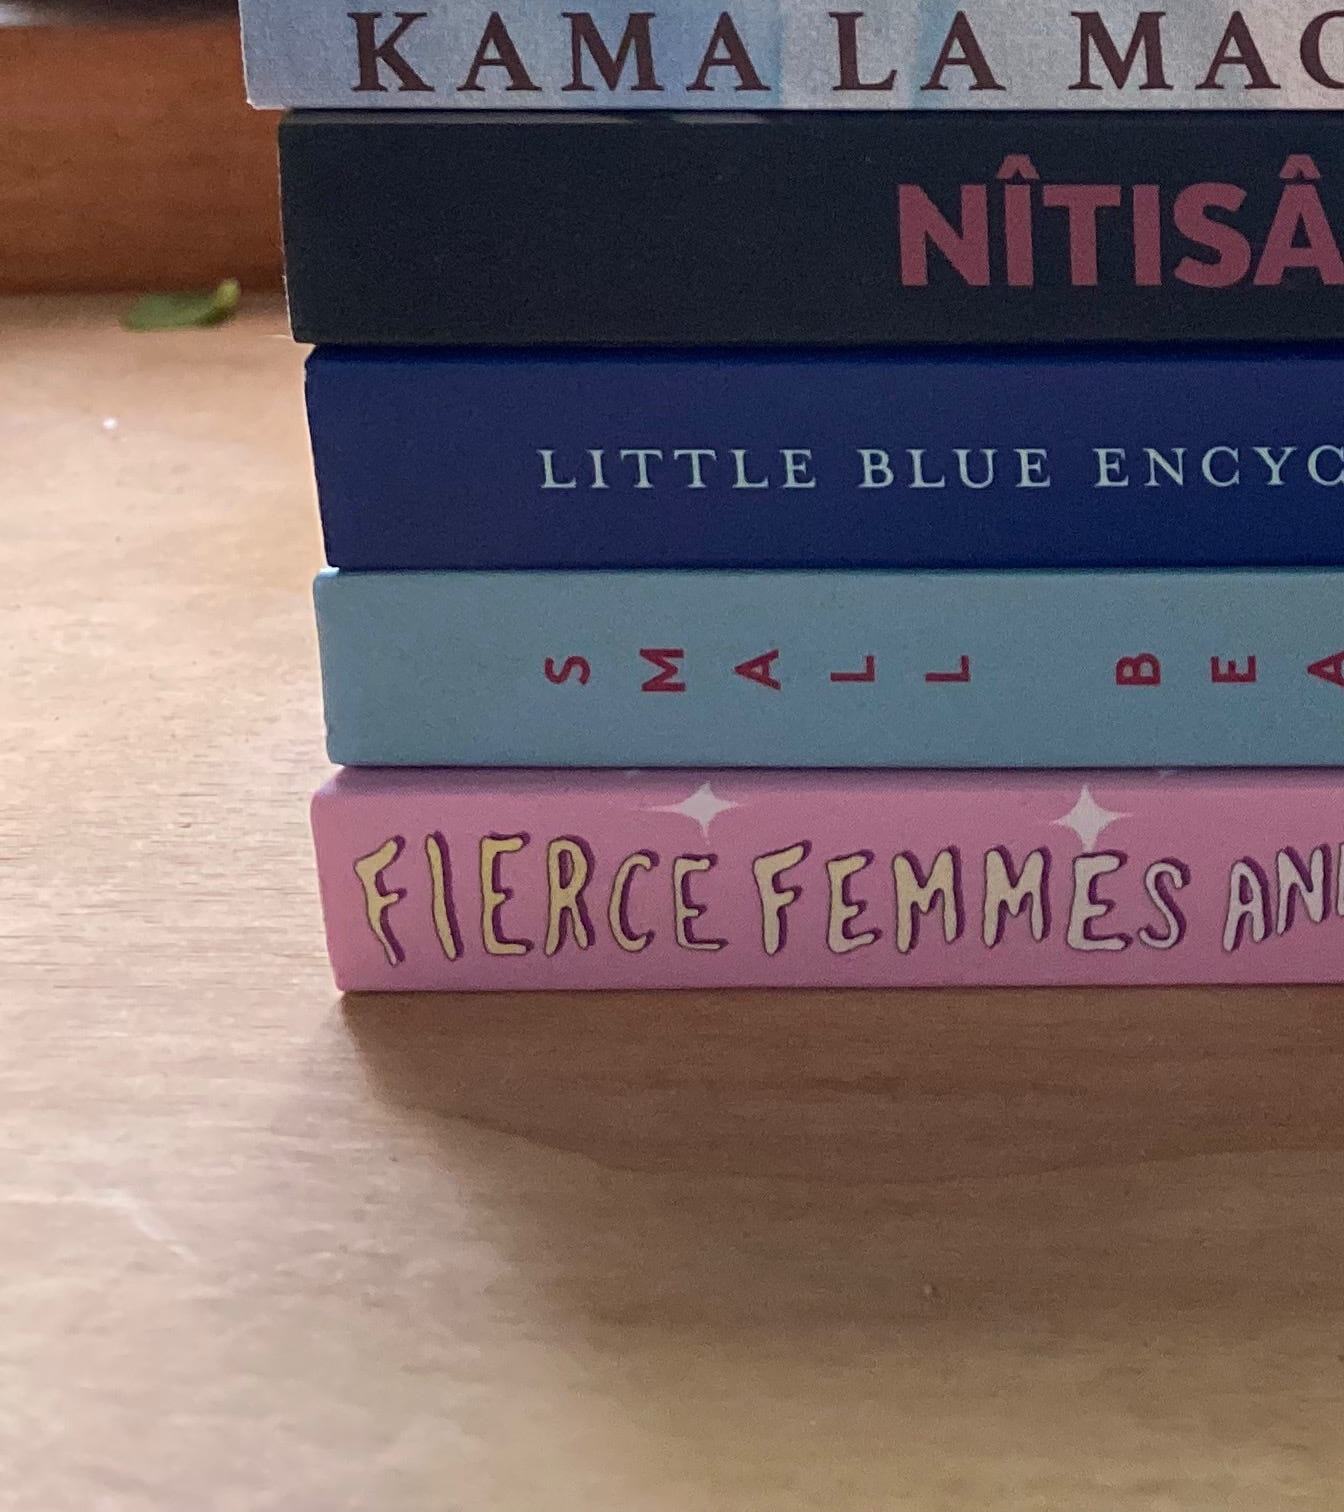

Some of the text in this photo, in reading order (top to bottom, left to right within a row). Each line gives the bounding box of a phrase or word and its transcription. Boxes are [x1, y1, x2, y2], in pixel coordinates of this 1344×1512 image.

[346, 10, 771, 92] KAMA
[828, 10, 1007, 91] LA
[538, 448, 816, 491] LITTLE
[858, 446, 1052, 489] BLUE
[544, 646, 972, 693] SMALL
[353, 831, 728, 968] FIERCE
[751, 839, 1191, 955] FEMMES
